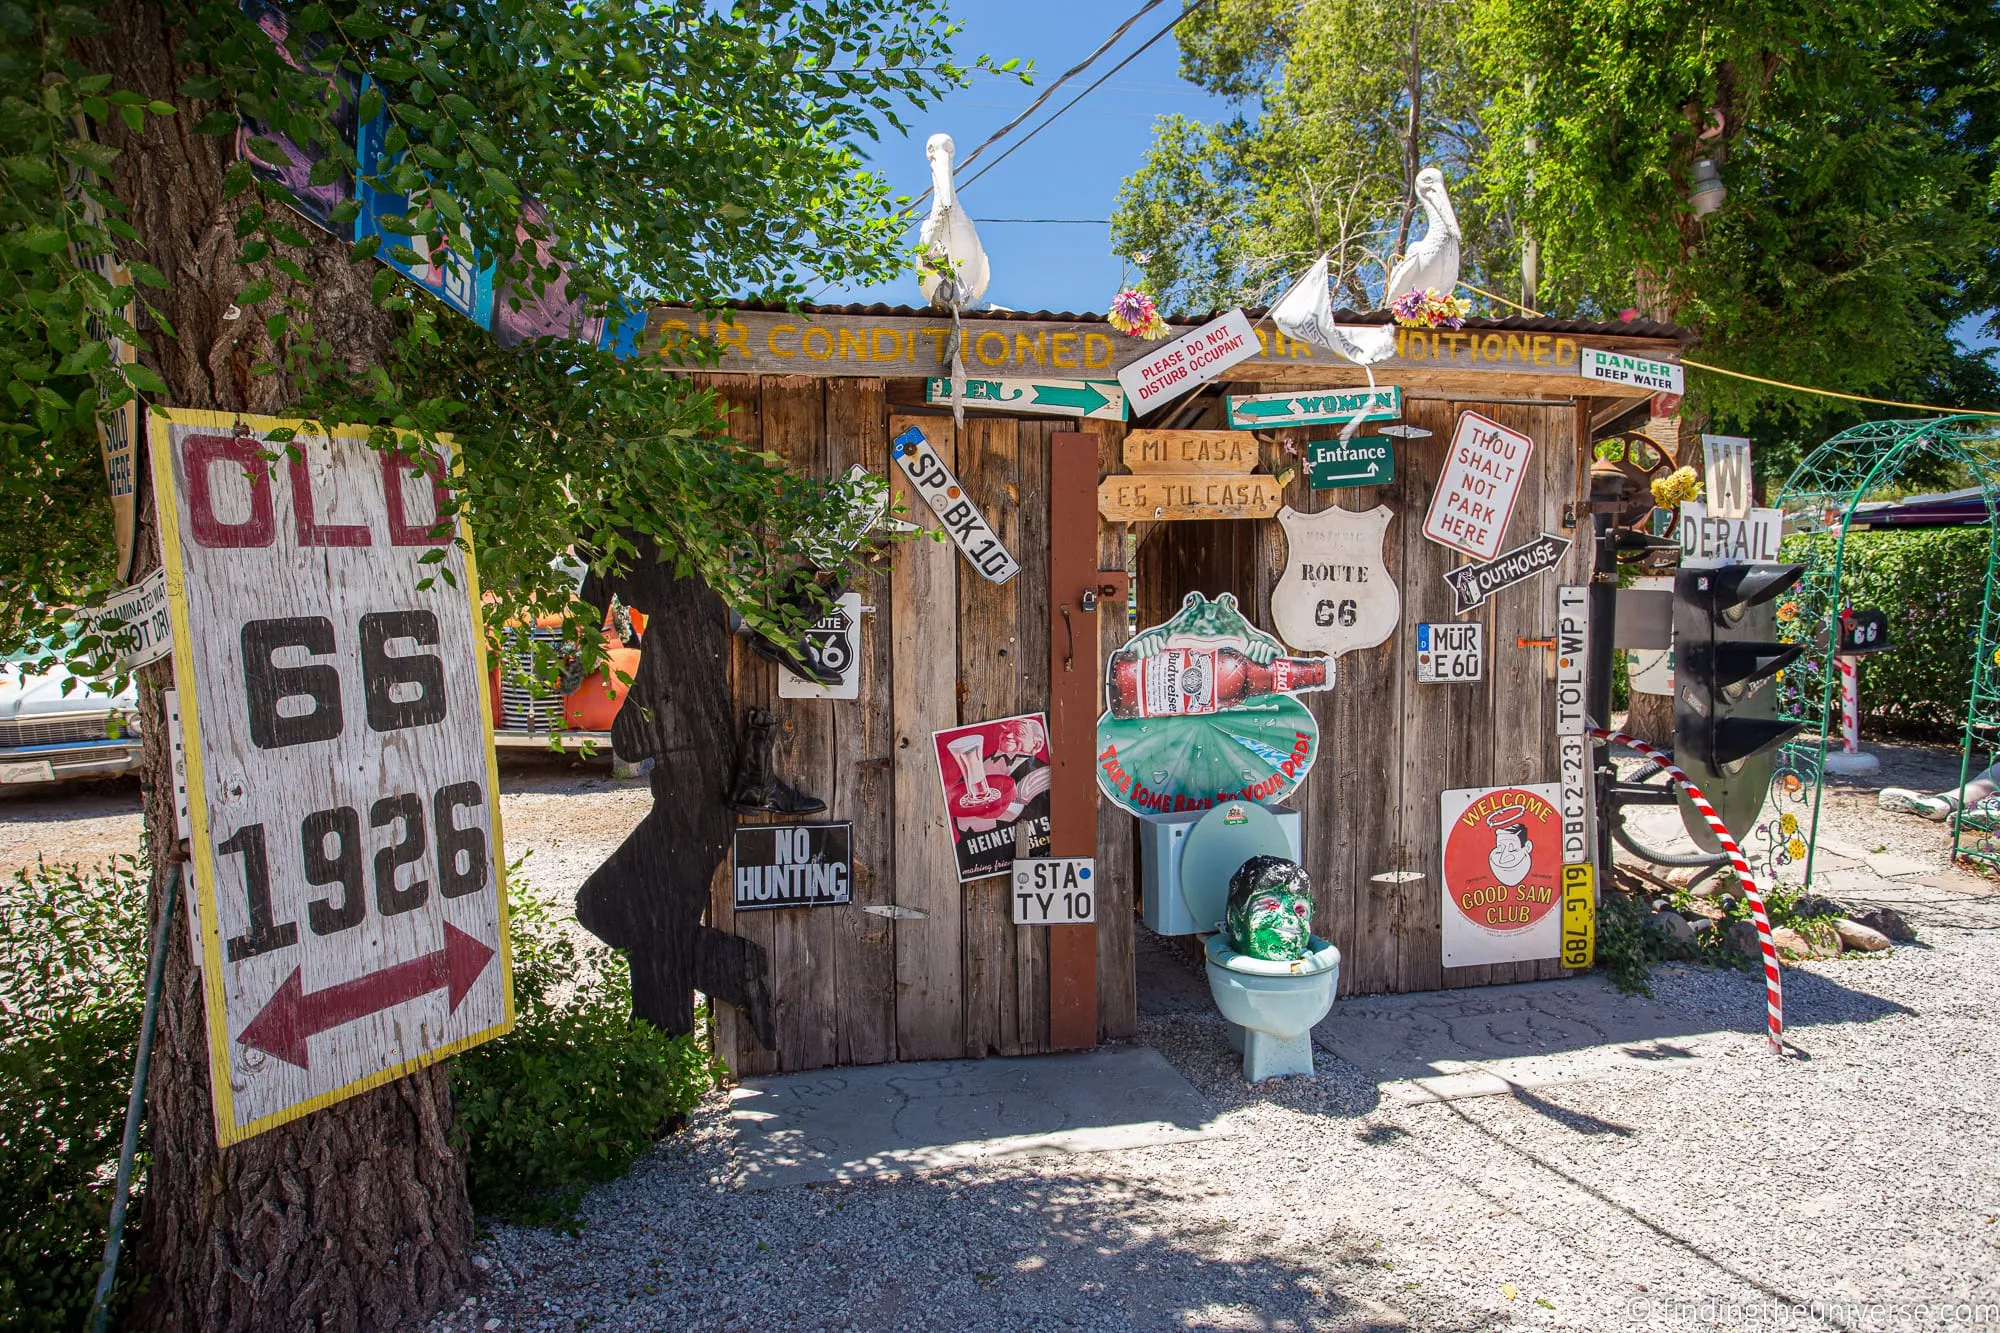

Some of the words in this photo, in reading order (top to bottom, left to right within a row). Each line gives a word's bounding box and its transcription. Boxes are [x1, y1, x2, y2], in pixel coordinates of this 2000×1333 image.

[767, 324, 1115, 369] CONDITIONED
[1141, 350, 1184, 380] PLEASE
[1186, 340, 1204, 356] DO
[1206, 325, 1230, 346] NOT
[1336, 328, 1578, 366] DITIONED
[1138, 366, 1188, 400] DISTURB
[1189, 334, 1244, 372] OCCUPANT
[1595, 366, 1628, 380] DEEP
[1634, 374, 1672, 390] WATER
[1596, 352, 1671, 377] DANGER
[104, 407, 128, 453] SOLD
[1471, 428, 1516, 460] THOU
[1142, 440, 1167, 461] MI
[1181, 439, 1242, 461] CASA
[1316, 447, 1386, 463] Entrance
[1458, 448, 1514, 483] SHALT
[107, 454, 132, 496] HERE
[182, 434, 455, 548] OLD
[1461, 473, 1496, 500] NOT
[1711, 443, 1742, 509] W
[1118, 484, 1147, 507] ES
[1162, 484, 1192, 506] TU
[1206, 484, 1265, 506] CASA
[1447, 492, 1495, 524] PARK
[908, 453, 947, 489] SP
[943, 501, 985, 545] BK
[969, 539, 1008, 576] 10
[1441, 513, 1488, 546] HERE
[1684, 515, 1775, 561] DERAIL
[1301, 563, 1369, 583] ROUTE
[1479, 542, 1557, 589] OUTHOUSE
[811, 617, 841, 629] UTE
[1315, 599, 1357, 627] 66
[1854, 622, 1877, 644] 66
[240, 610, 447, 750] 66
[1169, 651, 1179, 713] Budweiser
[1277, 661, 1292, 693] Bud
[1099, 744, 1133, 794] TAKE
[1130, 781, 1174, 813] SOME
[1240, 772, 1286, 802] YOUR
[1280, 732, 1312, 779] PAD!
[1462, 792, 1553, 827] WELCOME
[966, 816, 1050, 855] HEINEKN'S
[1565, 805, 1584, 852] DBC
[775, 828, 810, 865] NO
[218, 780, 488, 963] 1926
[737, 861, 847, 901] HUNTING
[962, 861, 993, 876] making
[1034, 861, 1079, 890] STA
[1017, 893, 1054, 920] TY
[1063, 892, 1091, 919] 10
[1461, 884, 1508, 911] GOOD
[1516, 884, 1553, 904] SAM
[1486, 905, 1531, 925] CLUB
